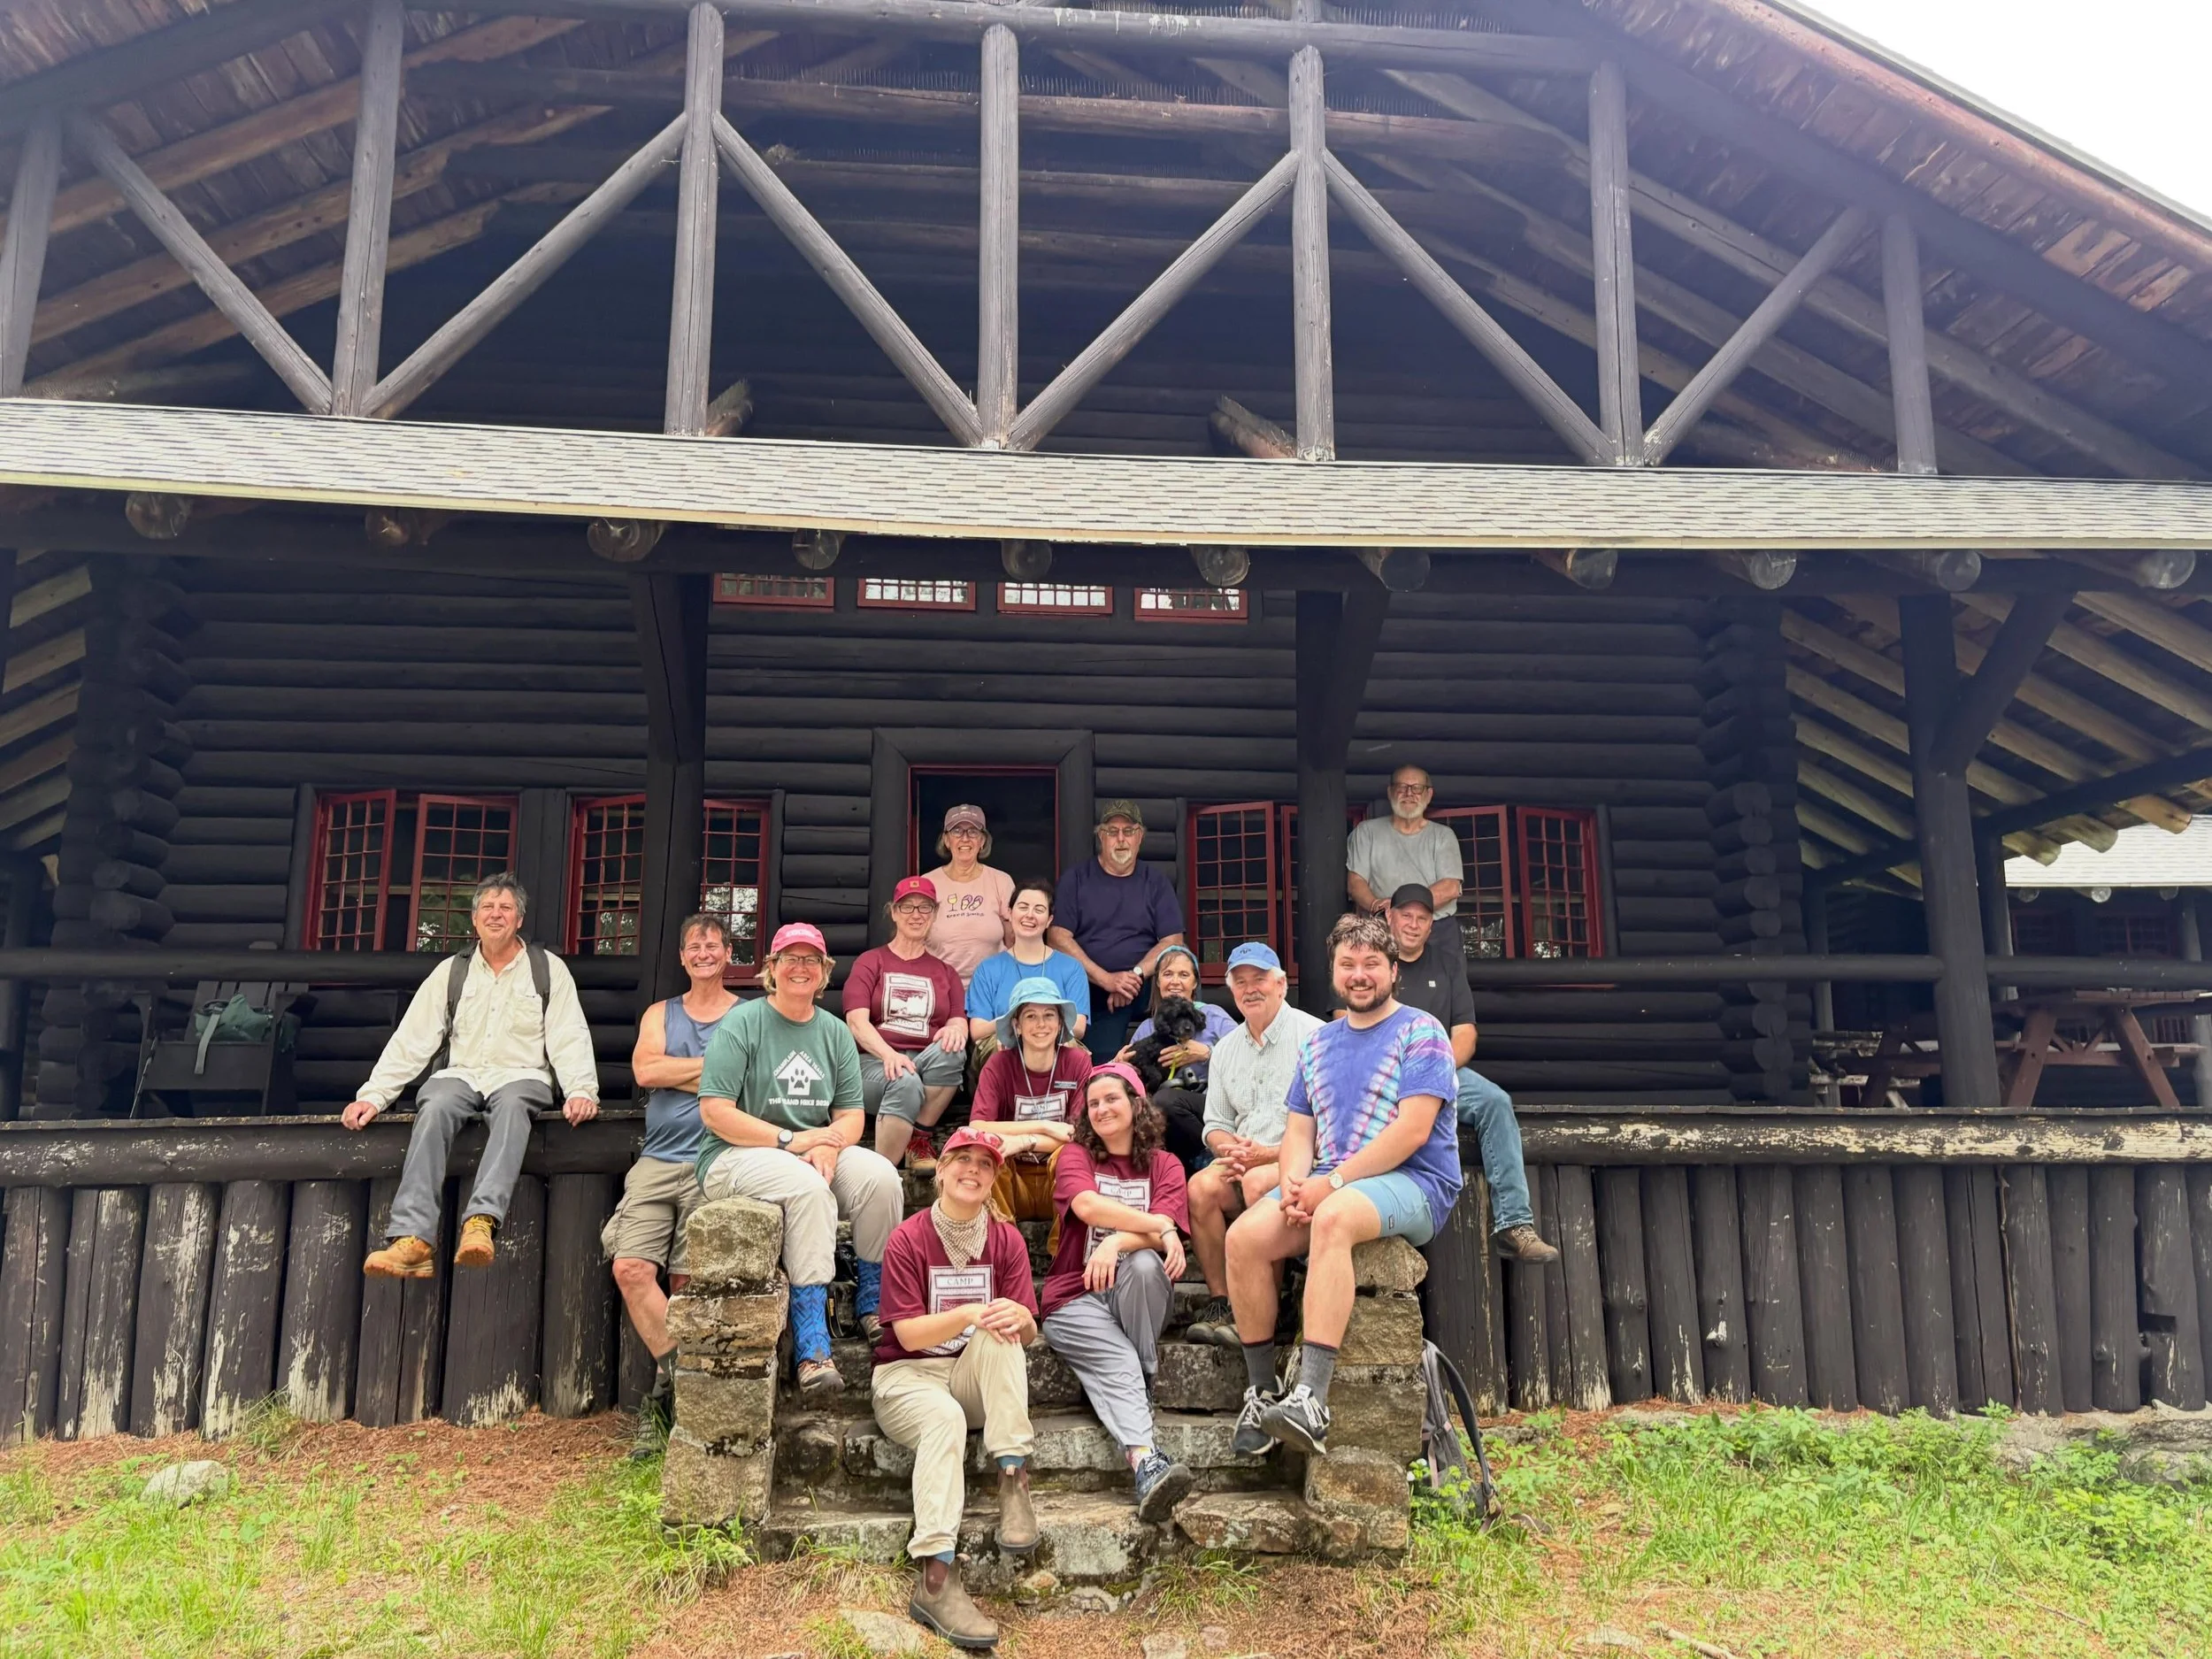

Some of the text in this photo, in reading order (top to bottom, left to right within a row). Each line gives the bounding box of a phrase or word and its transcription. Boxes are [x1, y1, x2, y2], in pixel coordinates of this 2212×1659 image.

[772, 1049, 826, 1079] CHAMPLAIN AREA TRAILS
[947, 1277, 973, 1286] CAMP
